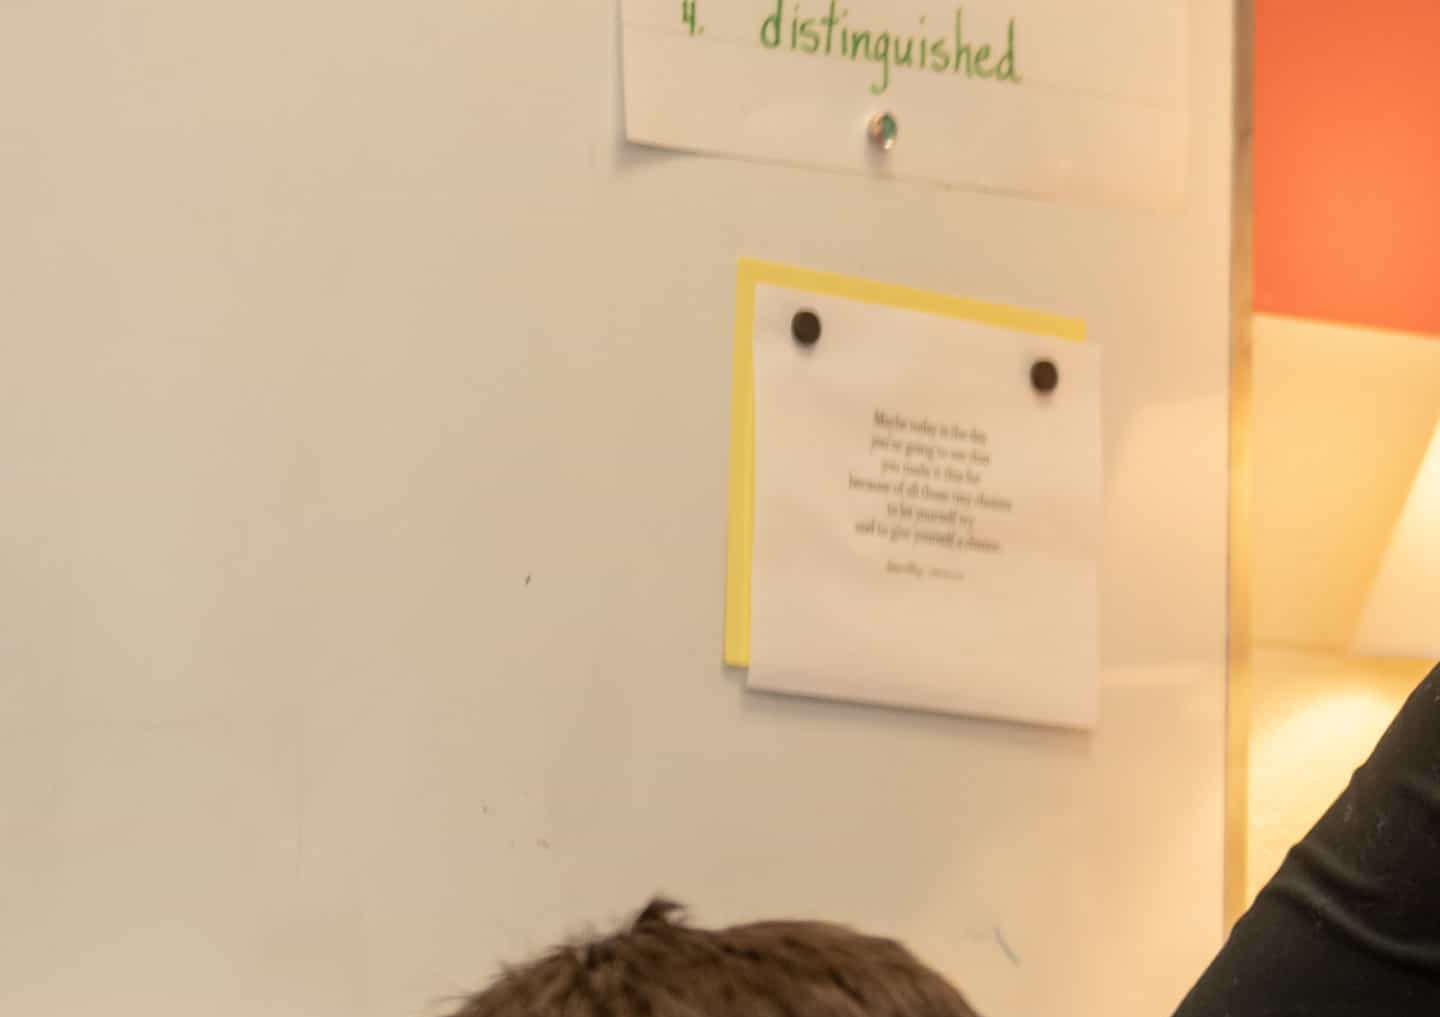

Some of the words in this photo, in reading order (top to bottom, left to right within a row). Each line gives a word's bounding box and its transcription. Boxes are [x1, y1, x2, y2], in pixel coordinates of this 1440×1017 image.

[760, 0, 1021, 95] distinguished
[874, 409, 907, 428] Maybe
[909, 420, 936, 437] today
[951, 425, 967, 439] the
[969, 429, 986, 446] day
[856, 518, 875, 535] and
